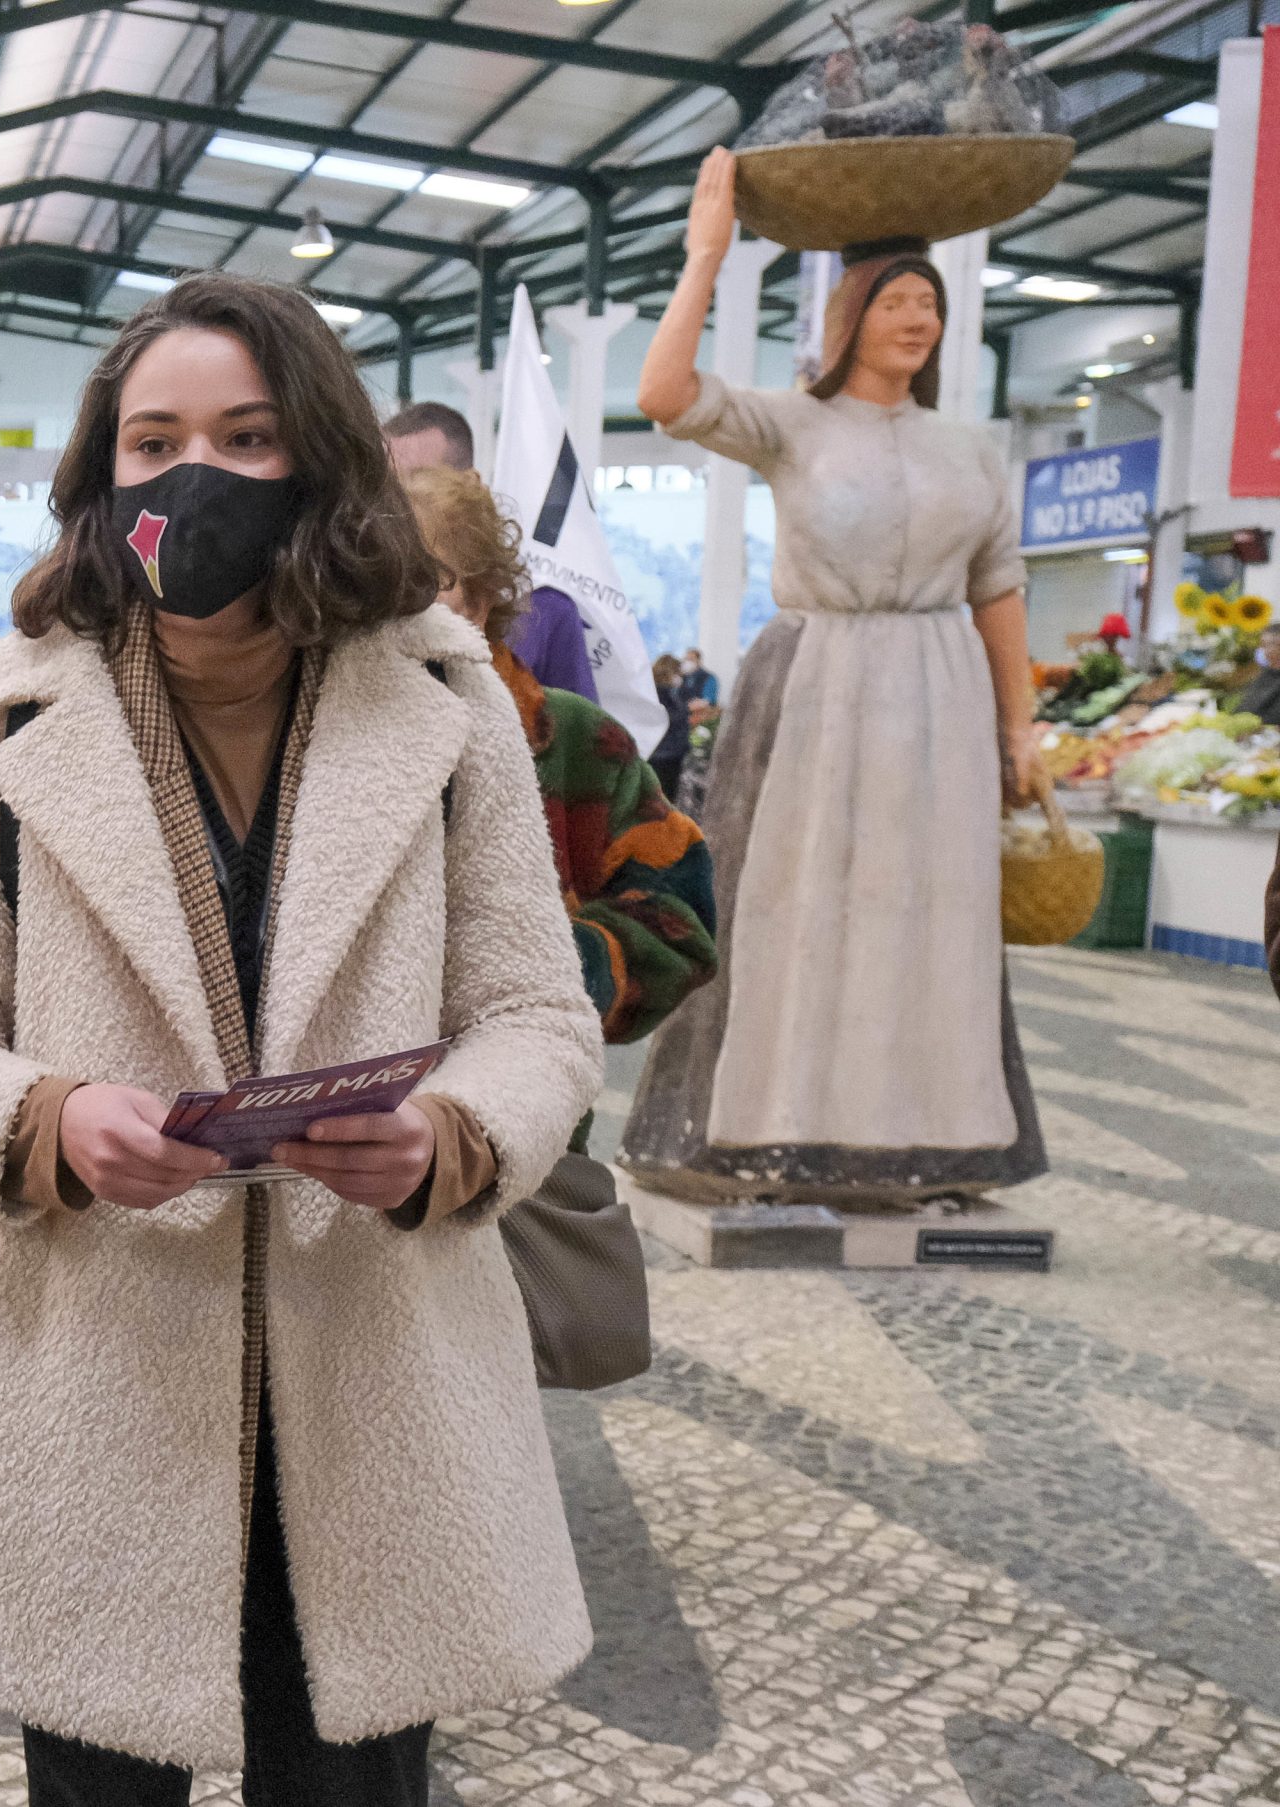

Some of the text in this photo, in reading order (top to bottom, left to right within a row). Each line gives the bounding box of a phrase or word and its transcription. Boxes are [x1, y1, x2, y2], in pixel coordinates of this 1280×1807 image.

[1061, 454, 1122, 497] LOJAS
[1033, 503, 1065, 537] NO
[1098, 491, 1147, 530] PISO
[523, 550, 627, 611] MOVIMENTO
[236, 1082, 324, 1110] VOTA
[328, 1059, 423, 1096] MAS
